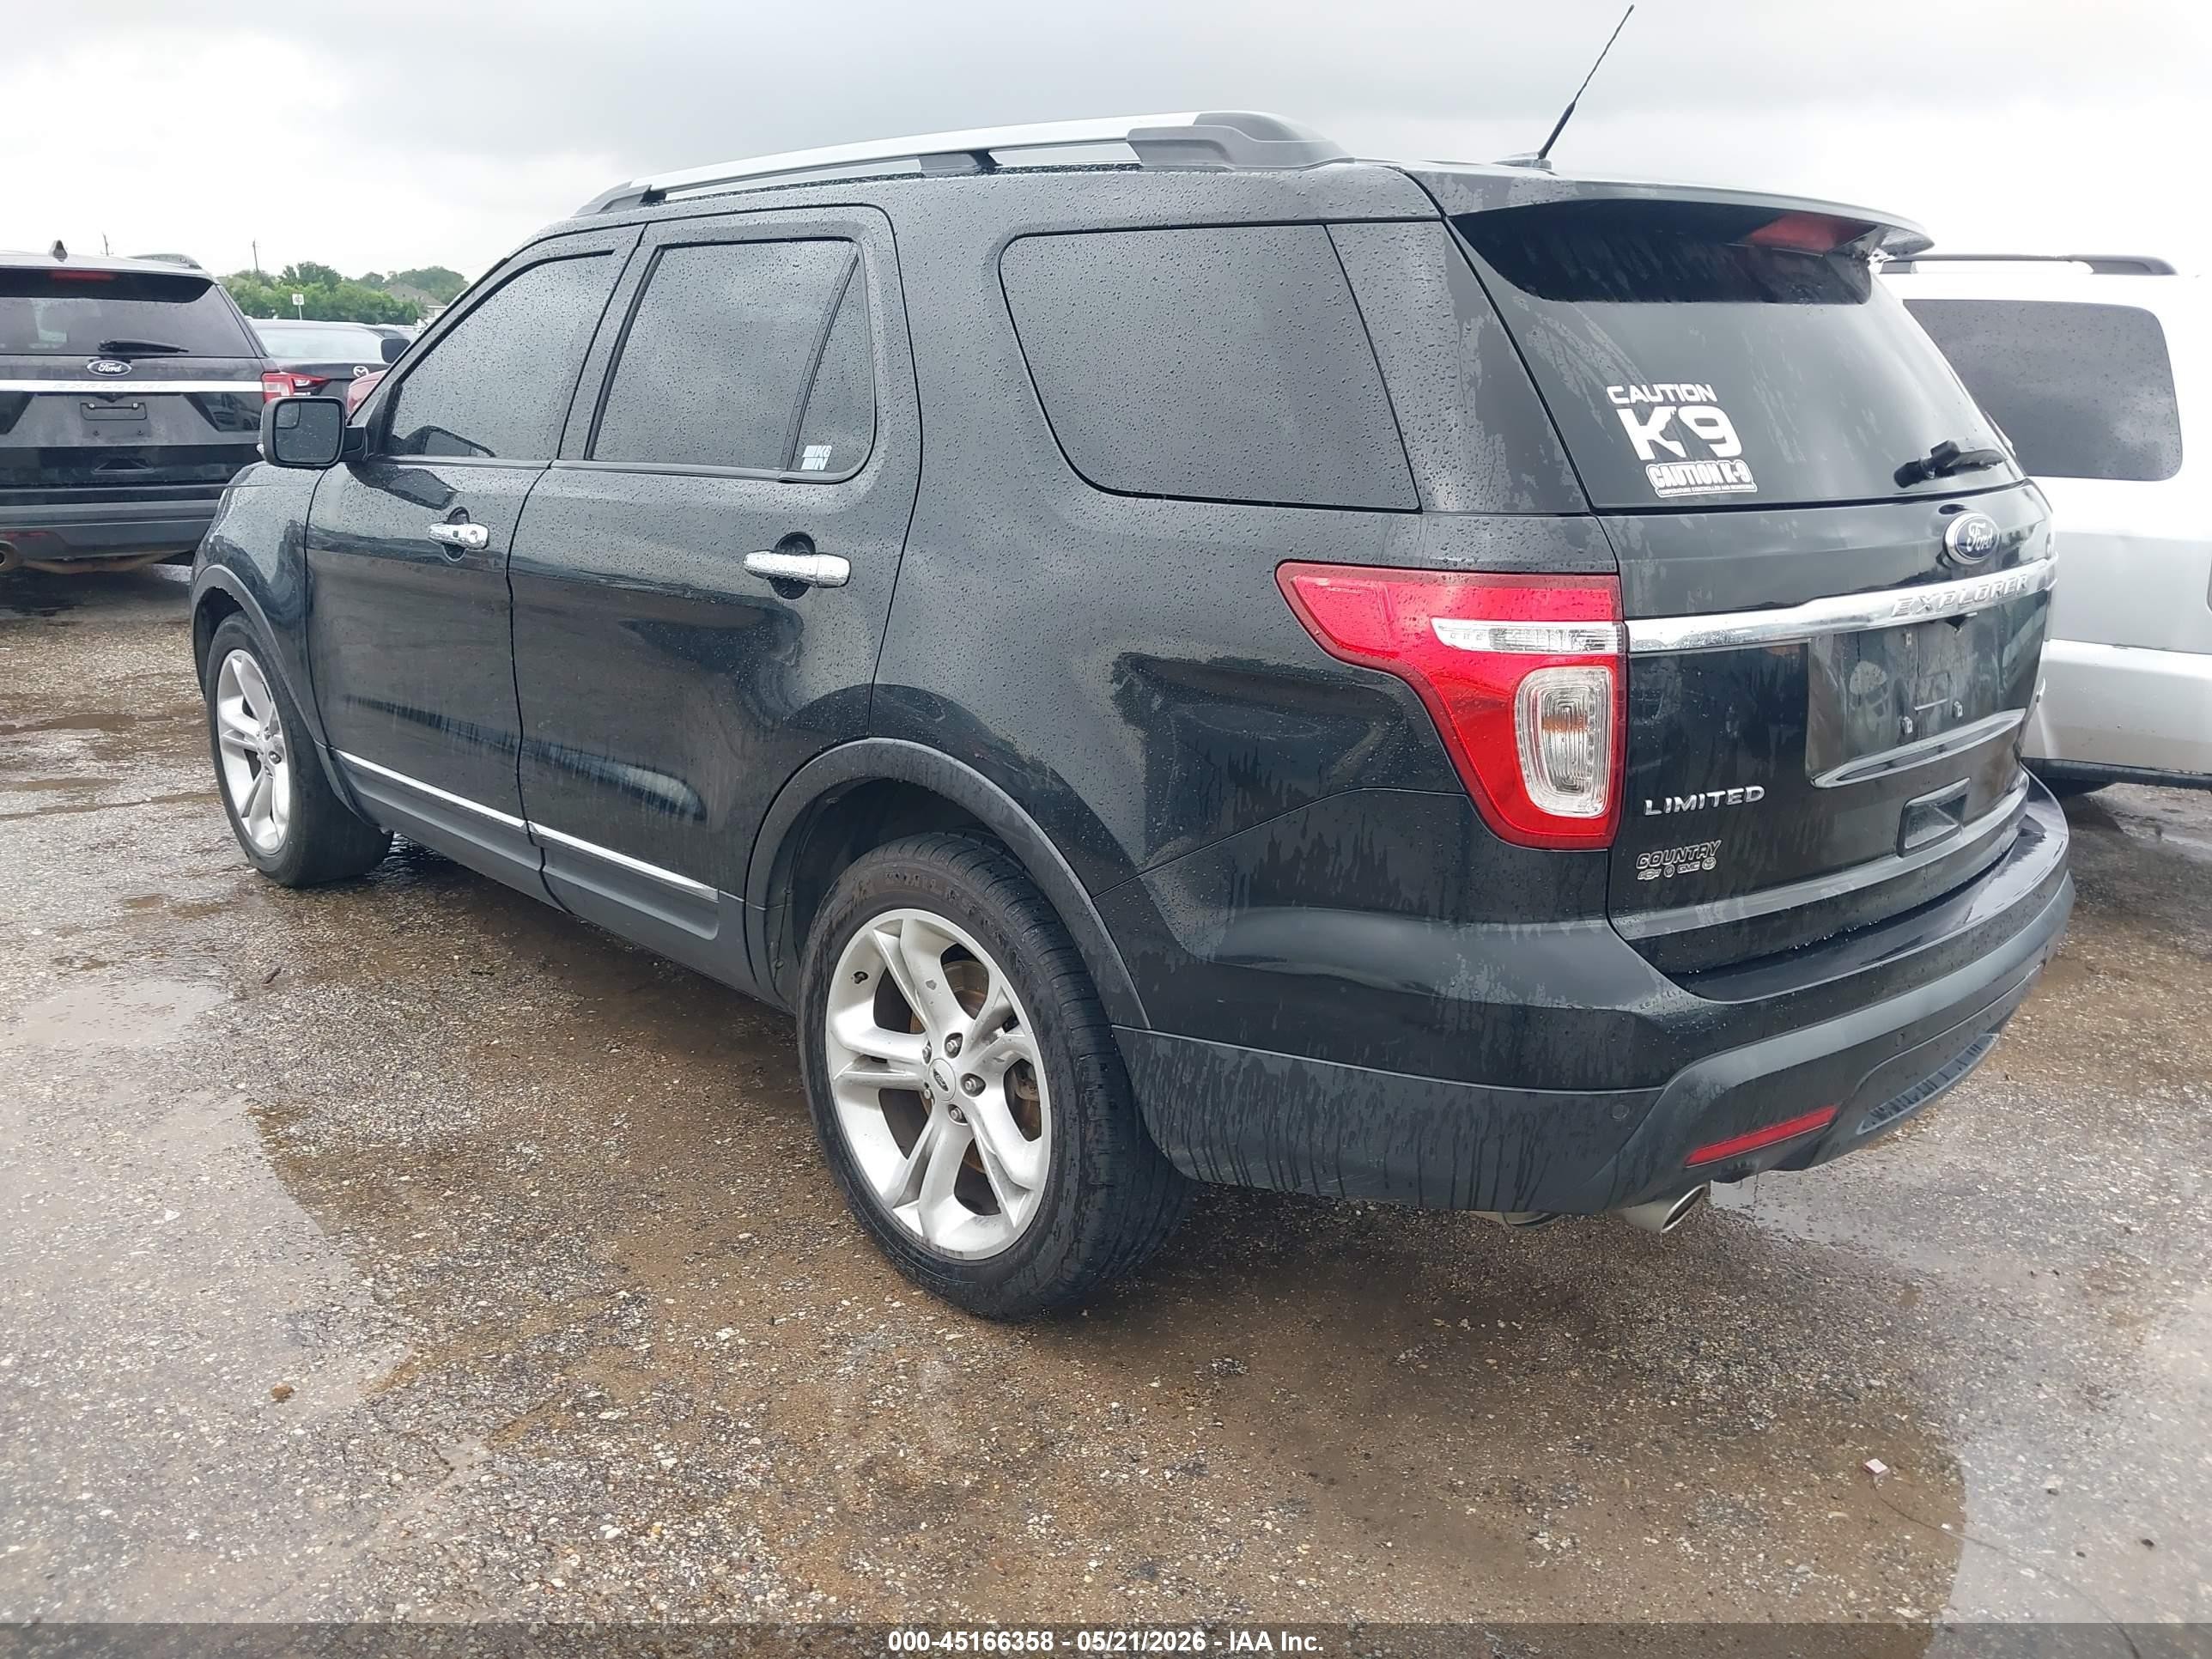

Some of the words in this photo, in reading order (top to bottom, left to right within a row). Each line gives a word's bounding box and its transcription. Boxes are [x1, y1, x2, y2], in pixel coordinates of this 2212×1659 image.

[98, 362, 122, 373] Ford
[1607, 384, 1718, 404] CAUTION
[1616, 405, 1742, 461] K9
[1649, 463, 1724, 489] CAUTION
[1720, 461, 1752, 483] K-9
[1966, 522, 1993, 552] Ford
[1891, 574, 2028, 617] EXPLORER
[1644, 785, 1765, 816] LIMITED
[1636, 840, 1722, 869] COUNTRY
